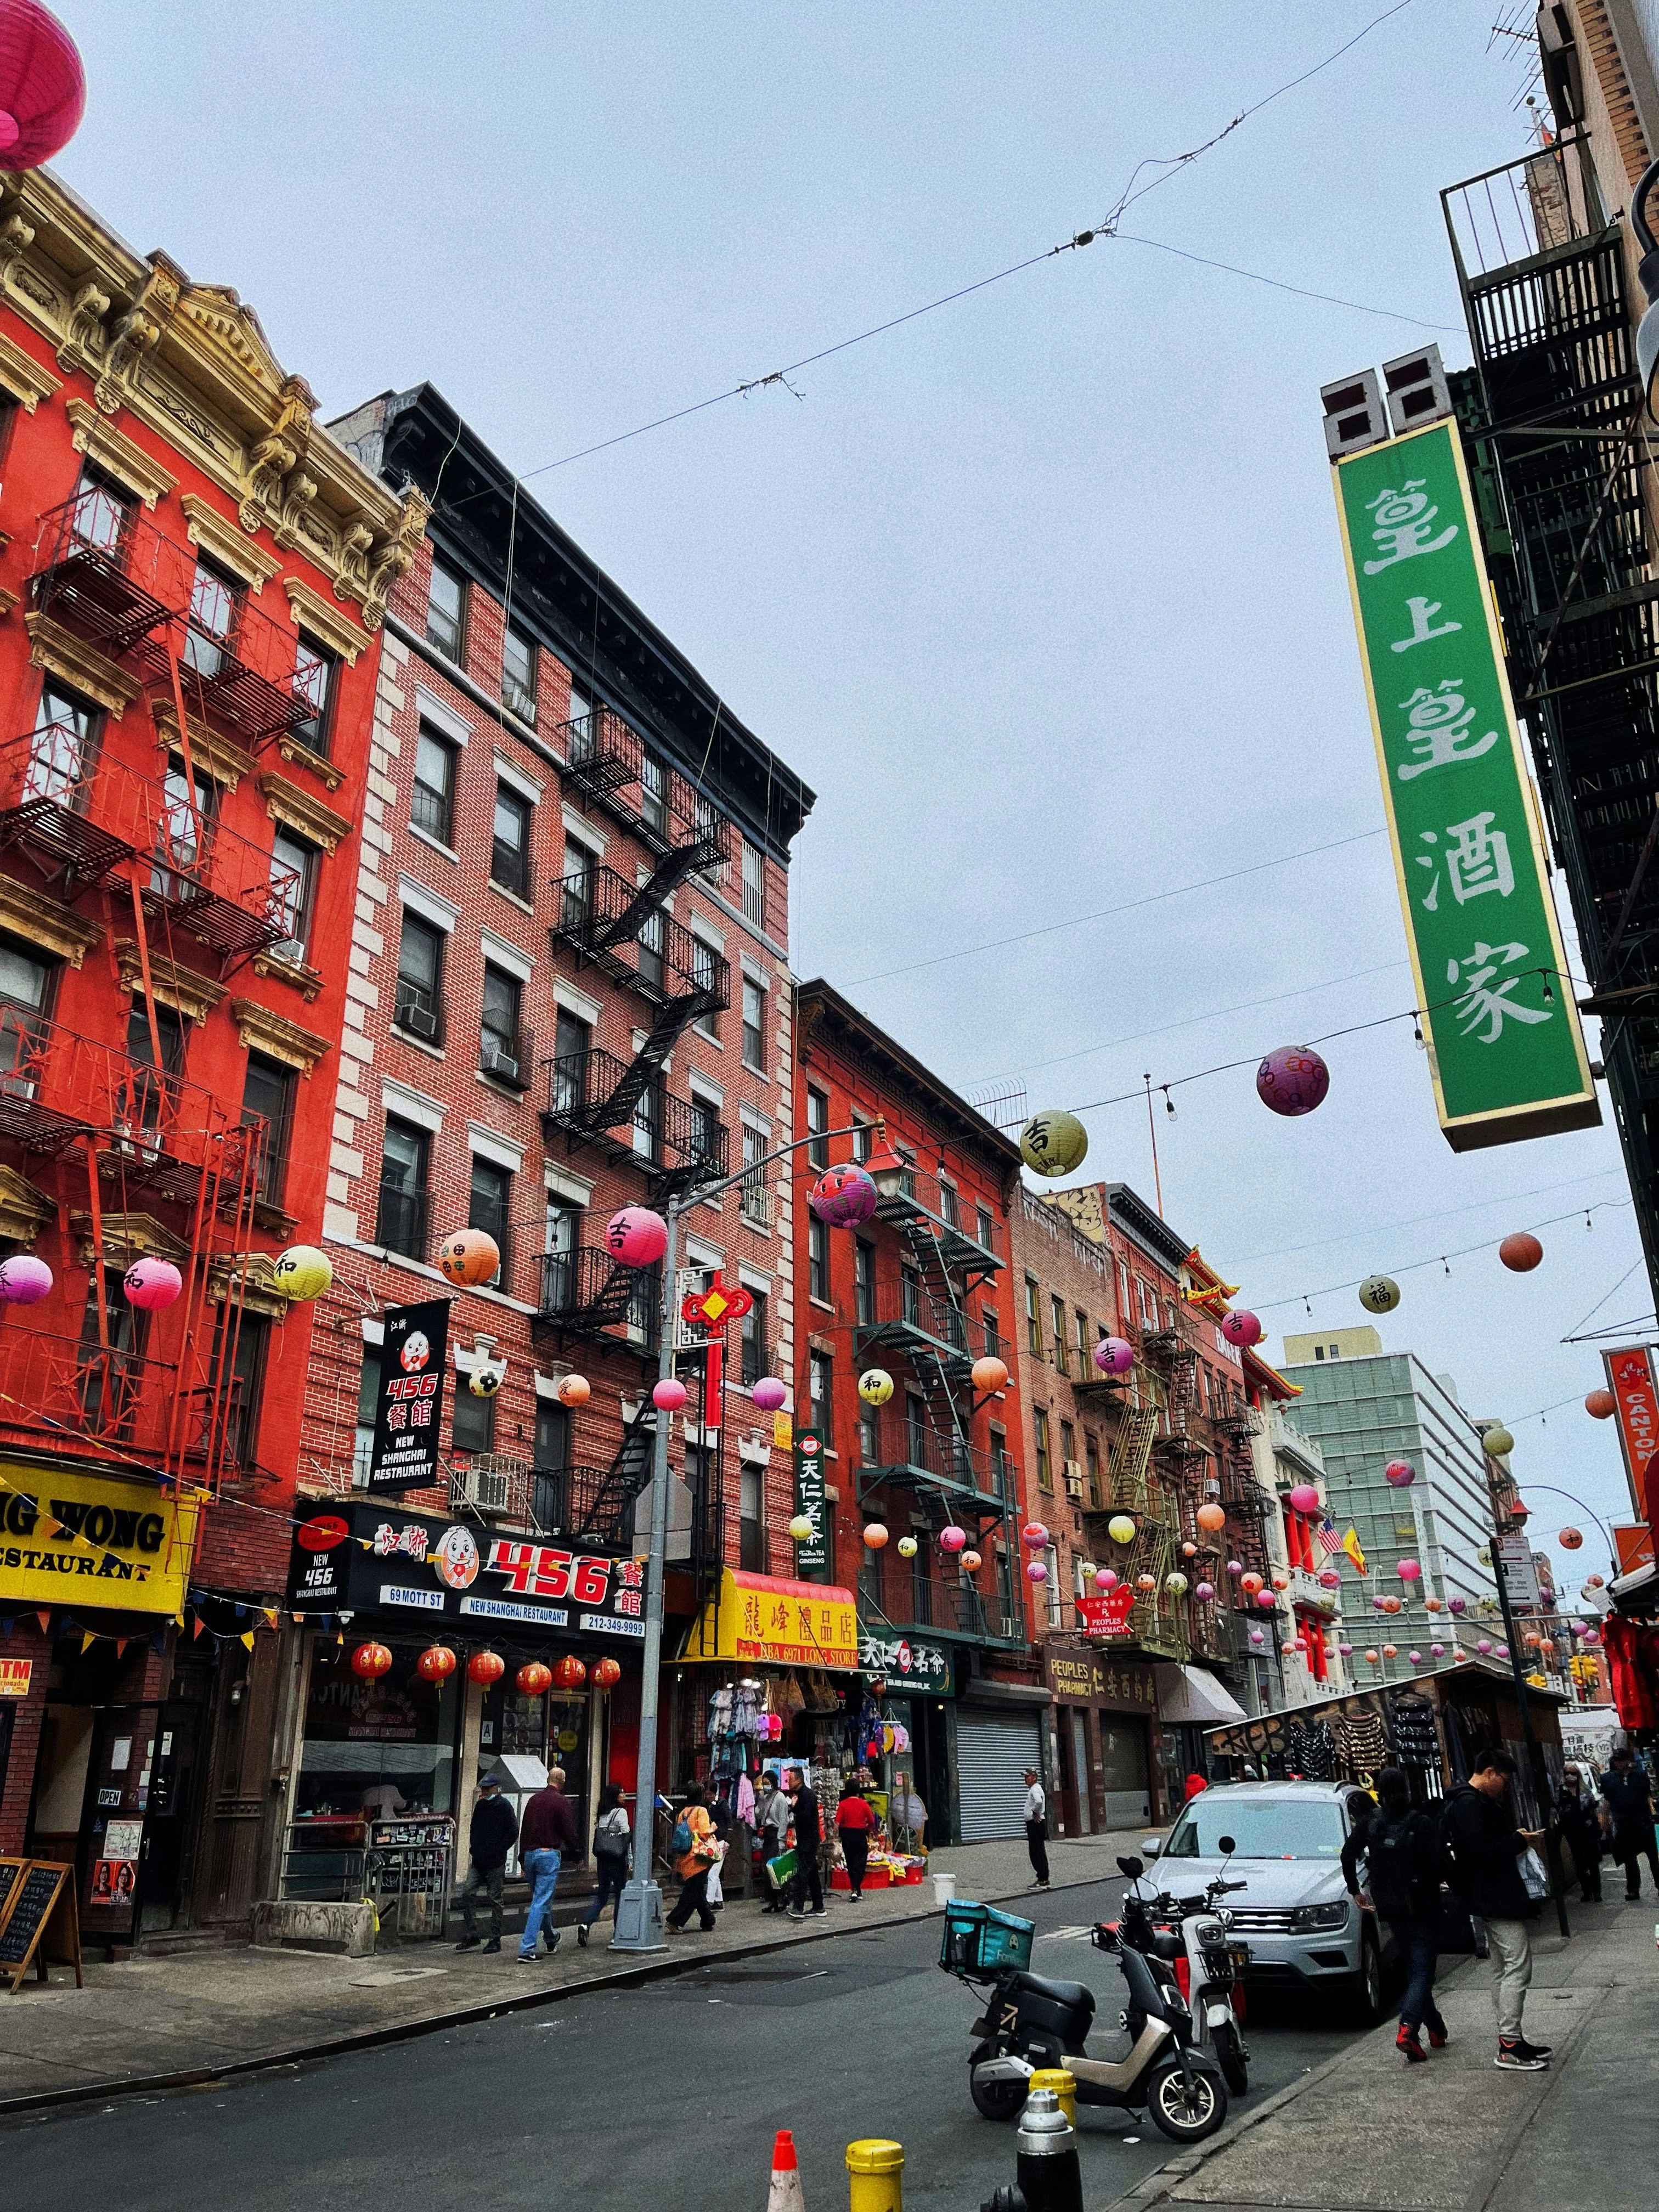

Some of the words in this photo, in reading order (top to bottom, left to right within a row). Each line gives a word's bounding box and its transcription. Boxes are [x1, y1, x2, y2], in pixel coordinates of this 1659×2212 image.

[1024, 1118, 1051, 1154] 吉
[610, 1217, 631, 1249] 吉
[275, 1256, 297, 1279] 和
[123, 1268, 143, 1289] 和
[1369, 1282, 1390, 1305] 福
[1227, 1313, 1243, 1332] 吉
[1101, 1344, 1116, 1364] 吉
[385, 1373, 438, 1401] 456
[864, 1375, 881, 1391] 和
[387, 1398, 433, 1431] 餐館
[395, 1435, 414, 1448] NEW
[381, 1448, 426, 1466] SHANGHAI
[374, 1463, 432, 1481] RESTAURANT
[799, 1460, 823, 1547] 天仁茗茶
[49, 1499, 166, 1553] WONG
[899, 1541, 909, 1550] 和
[0, 1548, 151, 1582] STAURANT
[313, 1554, 329, 1567] NEW
[964, 1555, 975, 1566] 和
[305, 1567, 334, 1587] 456
[483, 1540, 611, 1605] 456
[390, 1588, 400, 1601] 69
[402, 1590, 427, 1605] MOTT
[430, 1594, 441, 1606] ST
[620, 1561, 644, 1616] 餐館
[470, 1599, 486, 1613] NEW
[487, 1602, 522, 1618] SHANGHAI
[524, 1606, 565, 1623] RESTAURANT
[744, 1595, 851, 1644] 龍峰禮品店
[589, 1616, 642, 1634] 212-349-9999
[1089, 1626, 1125, 1635] PHARMACY
[1092, 1617, 1121, 1626] PEOPLES
[760, 1644, 780, 1660] DBA
[783, 1646, 801, 1662] 6971
[804, 1648, 827, 1664] LONG
[831, 1650, 856, 1666] STORE
[1, 1661, 31, 1679] TM
[99, 1790, 120, 1803] OPEN
